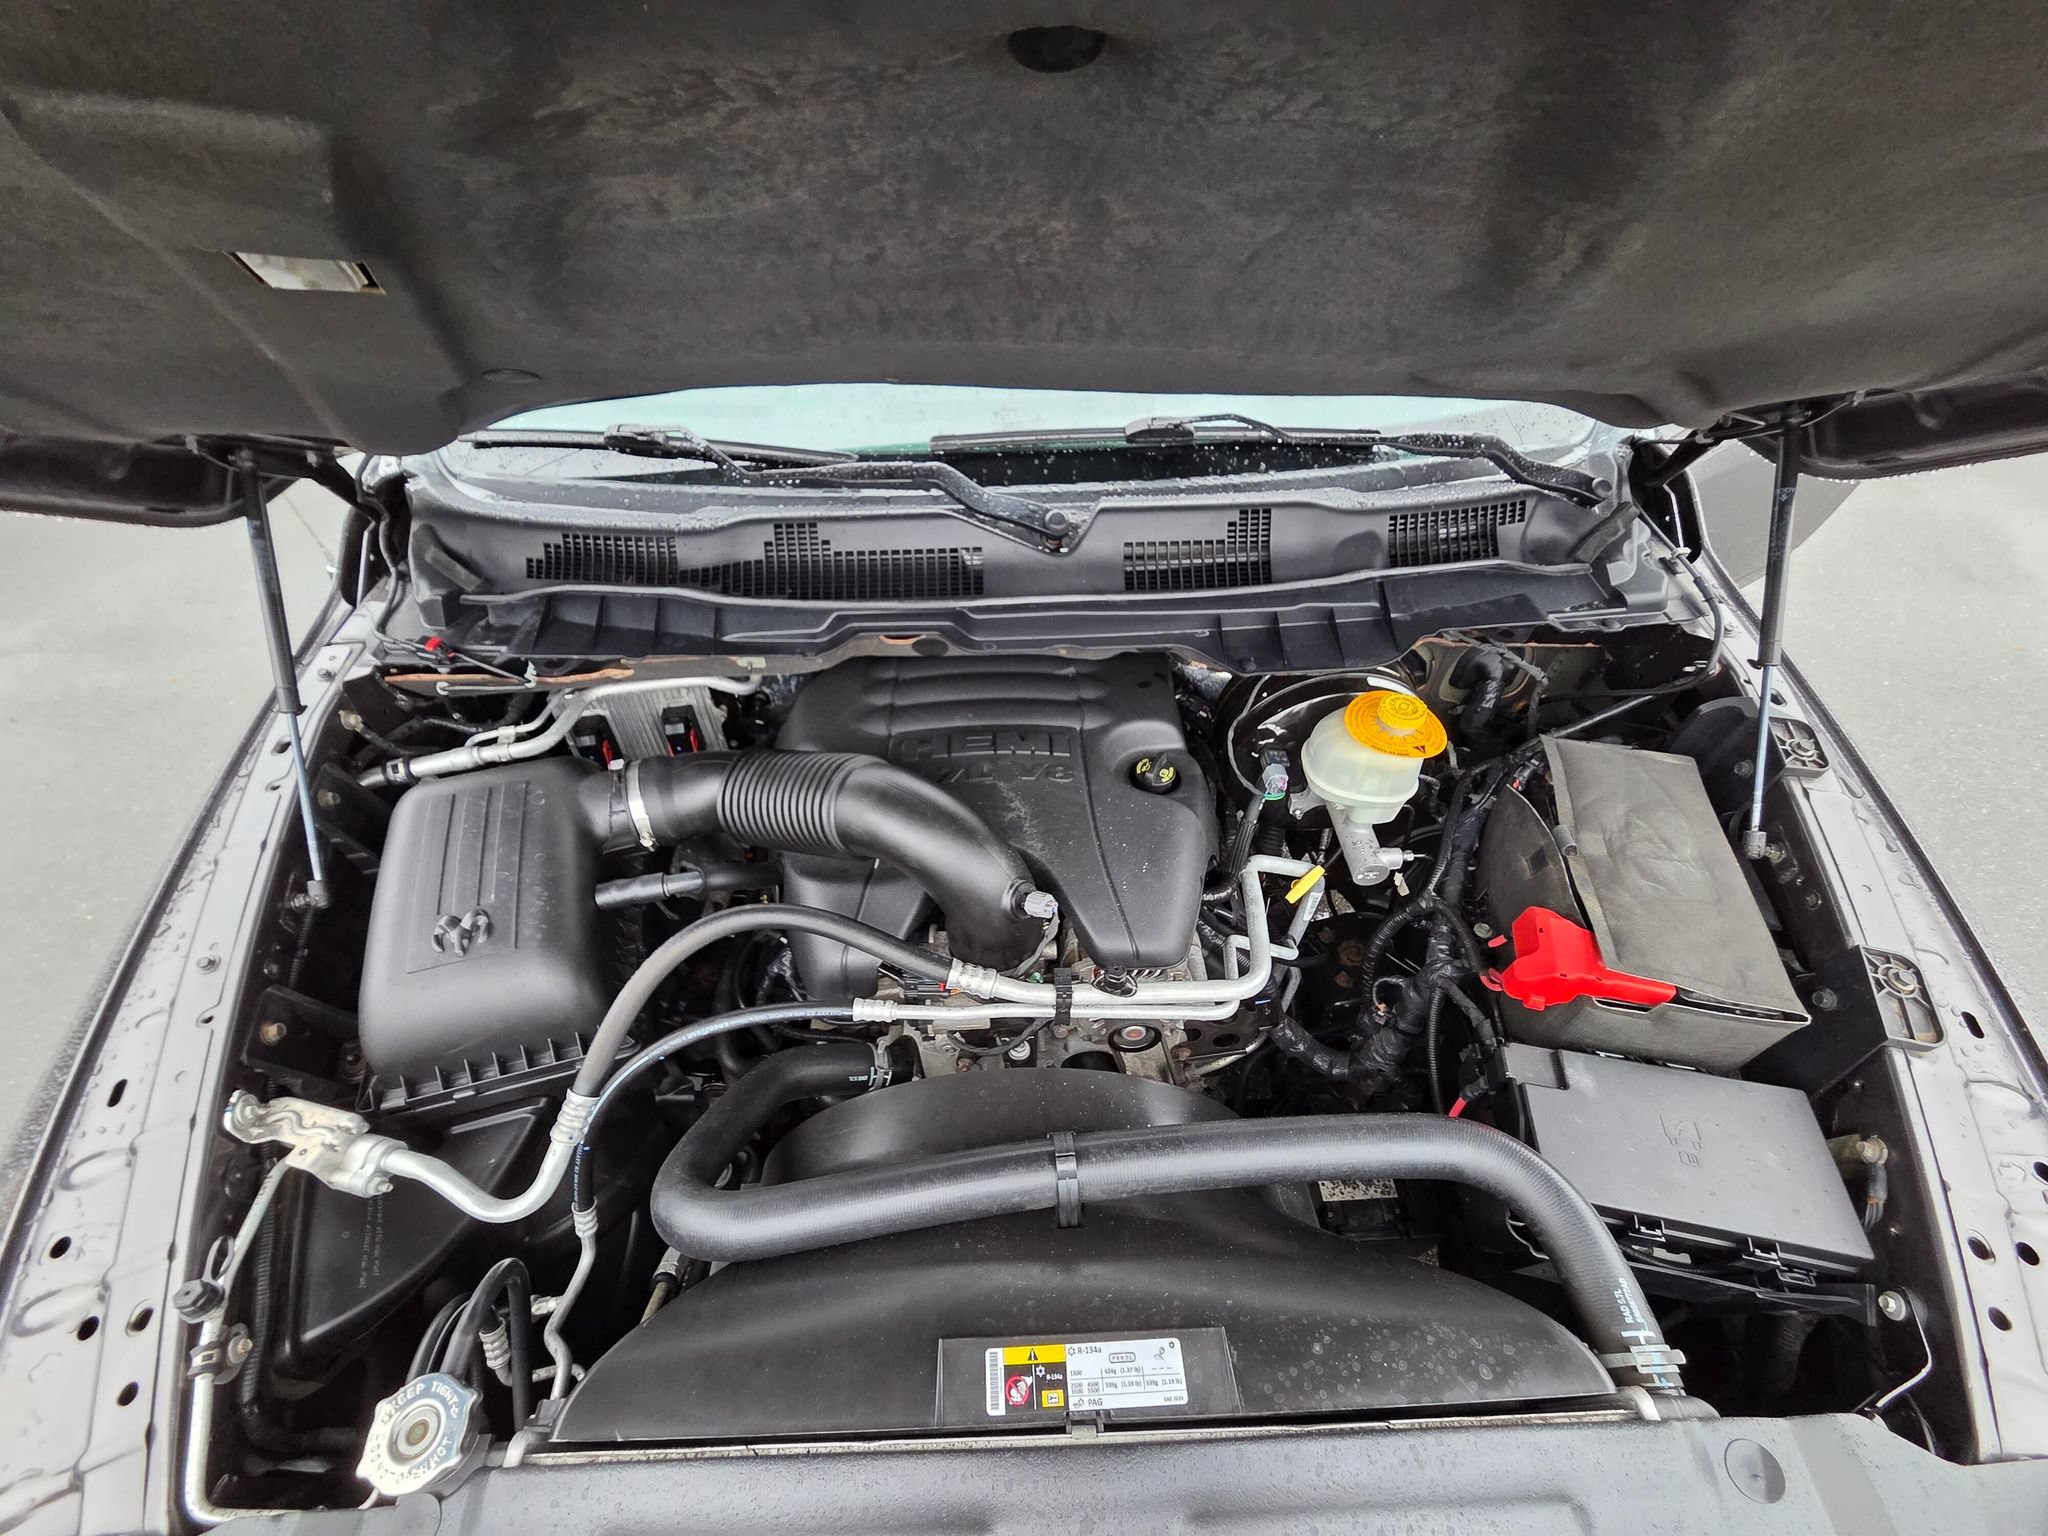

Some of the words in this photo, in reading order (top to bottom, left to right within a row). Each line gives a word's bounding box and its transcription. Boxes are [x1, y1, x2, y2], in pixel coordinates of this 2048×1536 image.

[900, 732, 1072, 760] HEMI
[1014, 763, 1075, 784] V8
[1620, 1305, 1635, 1324] RAD
[1077, 1346, 1102, 1355] R-134a
[390, 1383, 425, 1409] KEEP
[431, 1381, 459, 1405] TIGHT
[1087, 1397, 1103, 1407] PAG
